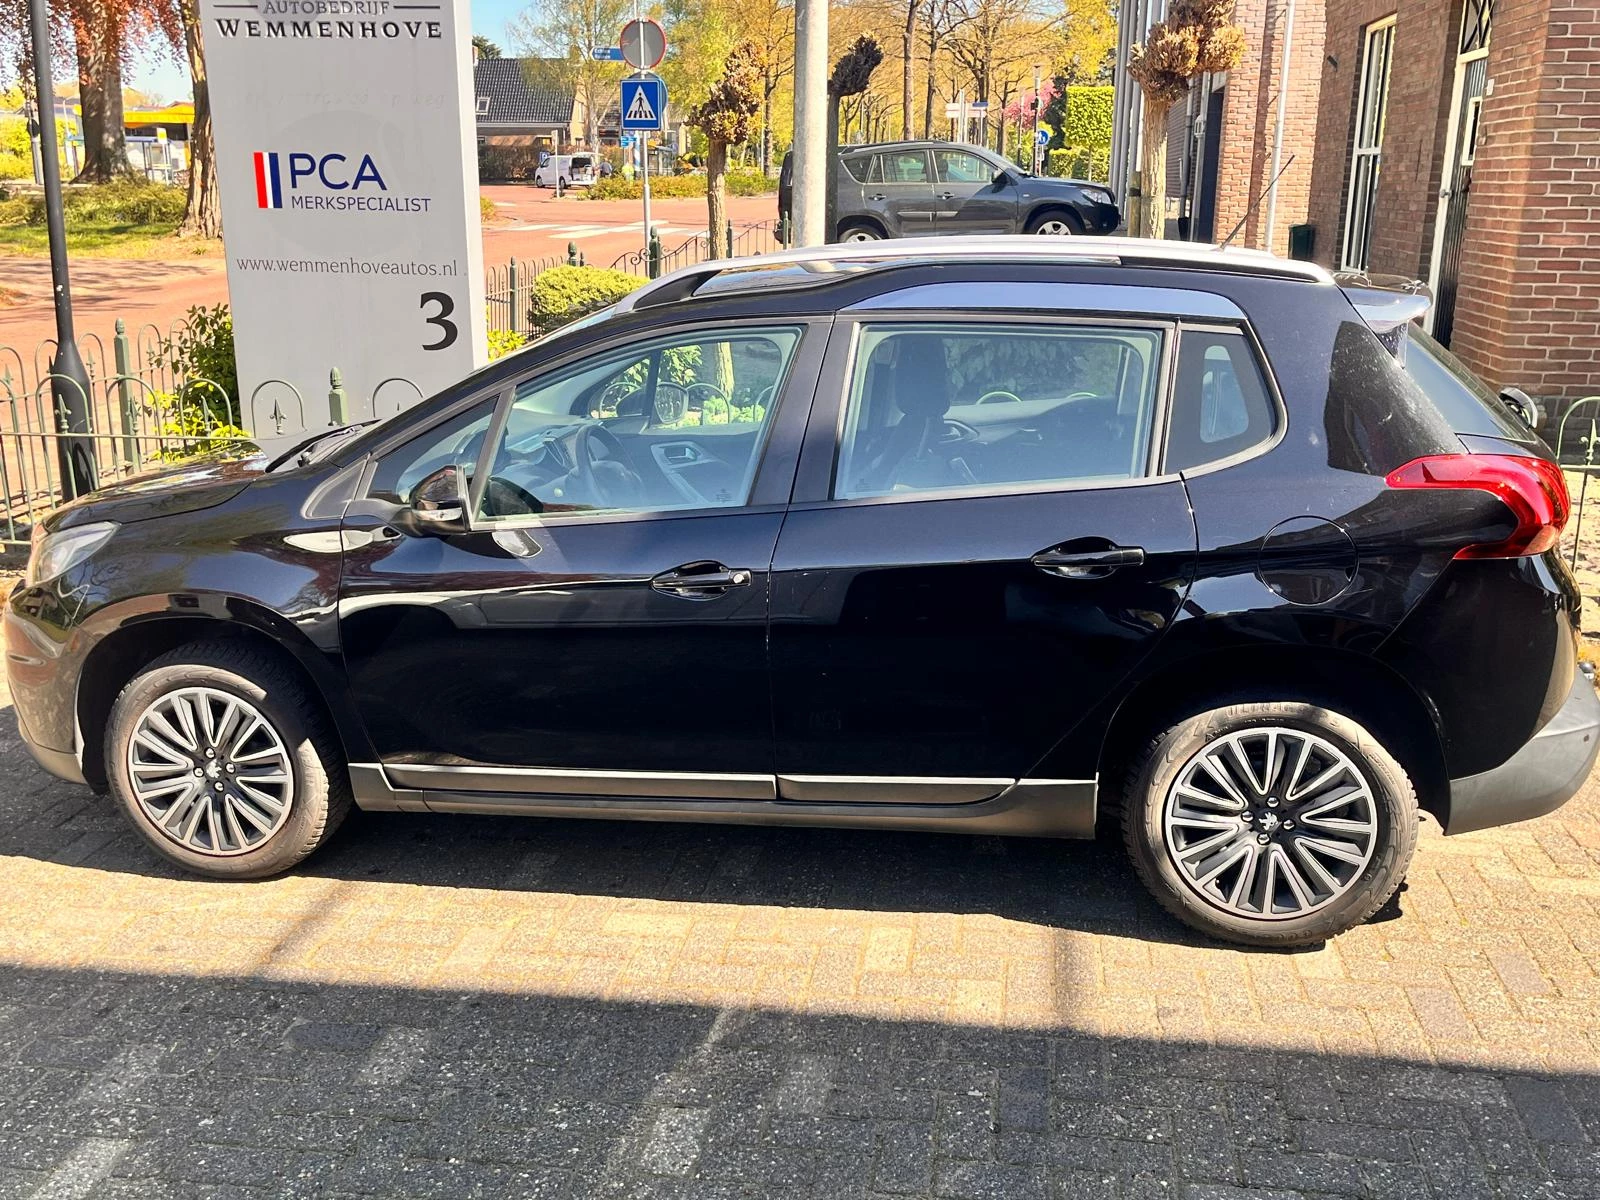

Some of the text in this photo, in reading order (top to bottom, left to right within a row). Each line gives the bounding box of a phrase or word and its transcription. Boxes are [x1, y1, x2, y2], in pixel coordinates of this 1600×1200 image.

[263, 0, 390, 15] AUTOBEDRIJF
[214, 18, 442, 39] WEMMENHOVE
[289, 153, 388, 191] PCA
[291, 196, 432, 212] MERKSPECIALIST
[236, 257, 458, 277] www.wemmenhoveautos.nl
[419, 291, 459, 351] 3
